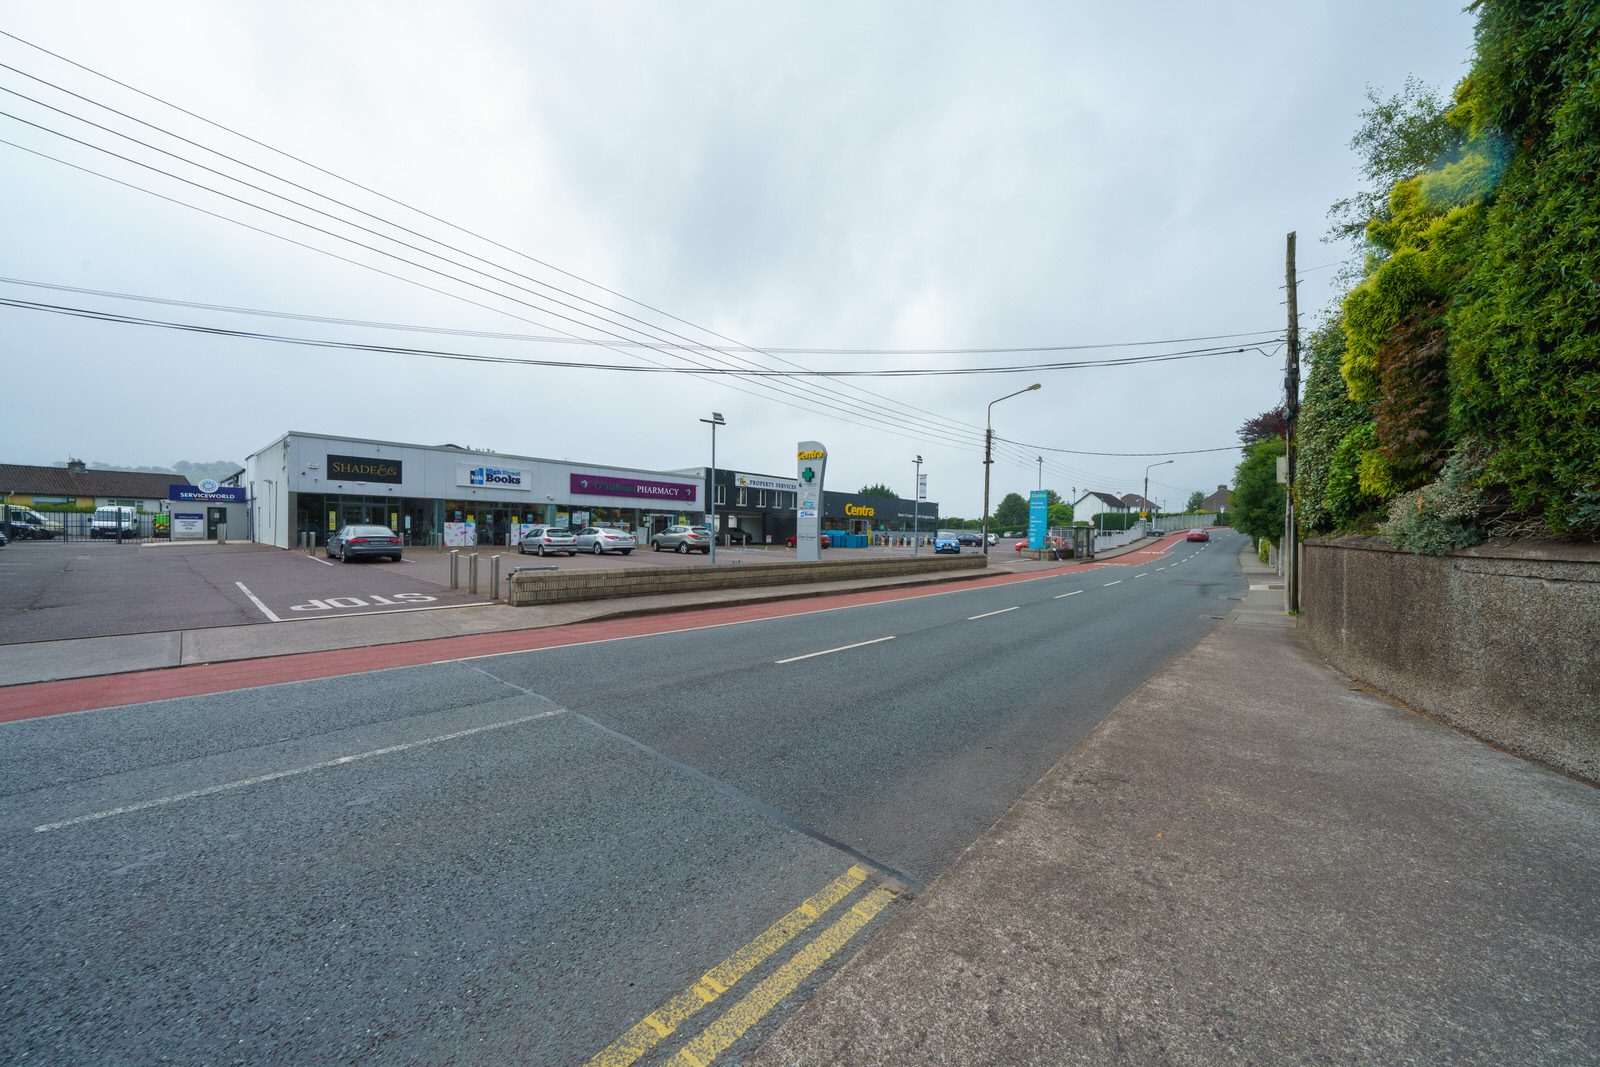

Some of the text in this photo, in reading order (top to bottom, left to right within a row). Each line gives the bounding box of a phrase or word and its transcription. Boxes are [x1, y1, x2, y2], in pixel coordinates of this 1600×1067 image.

[485, 473, 521, 485] Books
[636, 485, 680, 496] PHARMACY
[749, 480, 775, 489] PROPERTY
[775, 482, 797, 490] SERVICES
[180, 492, 235, 500] SERVICEWORLD
[844, 503, 875, 517] Centra
[290, 592, 438, 611] STOP
